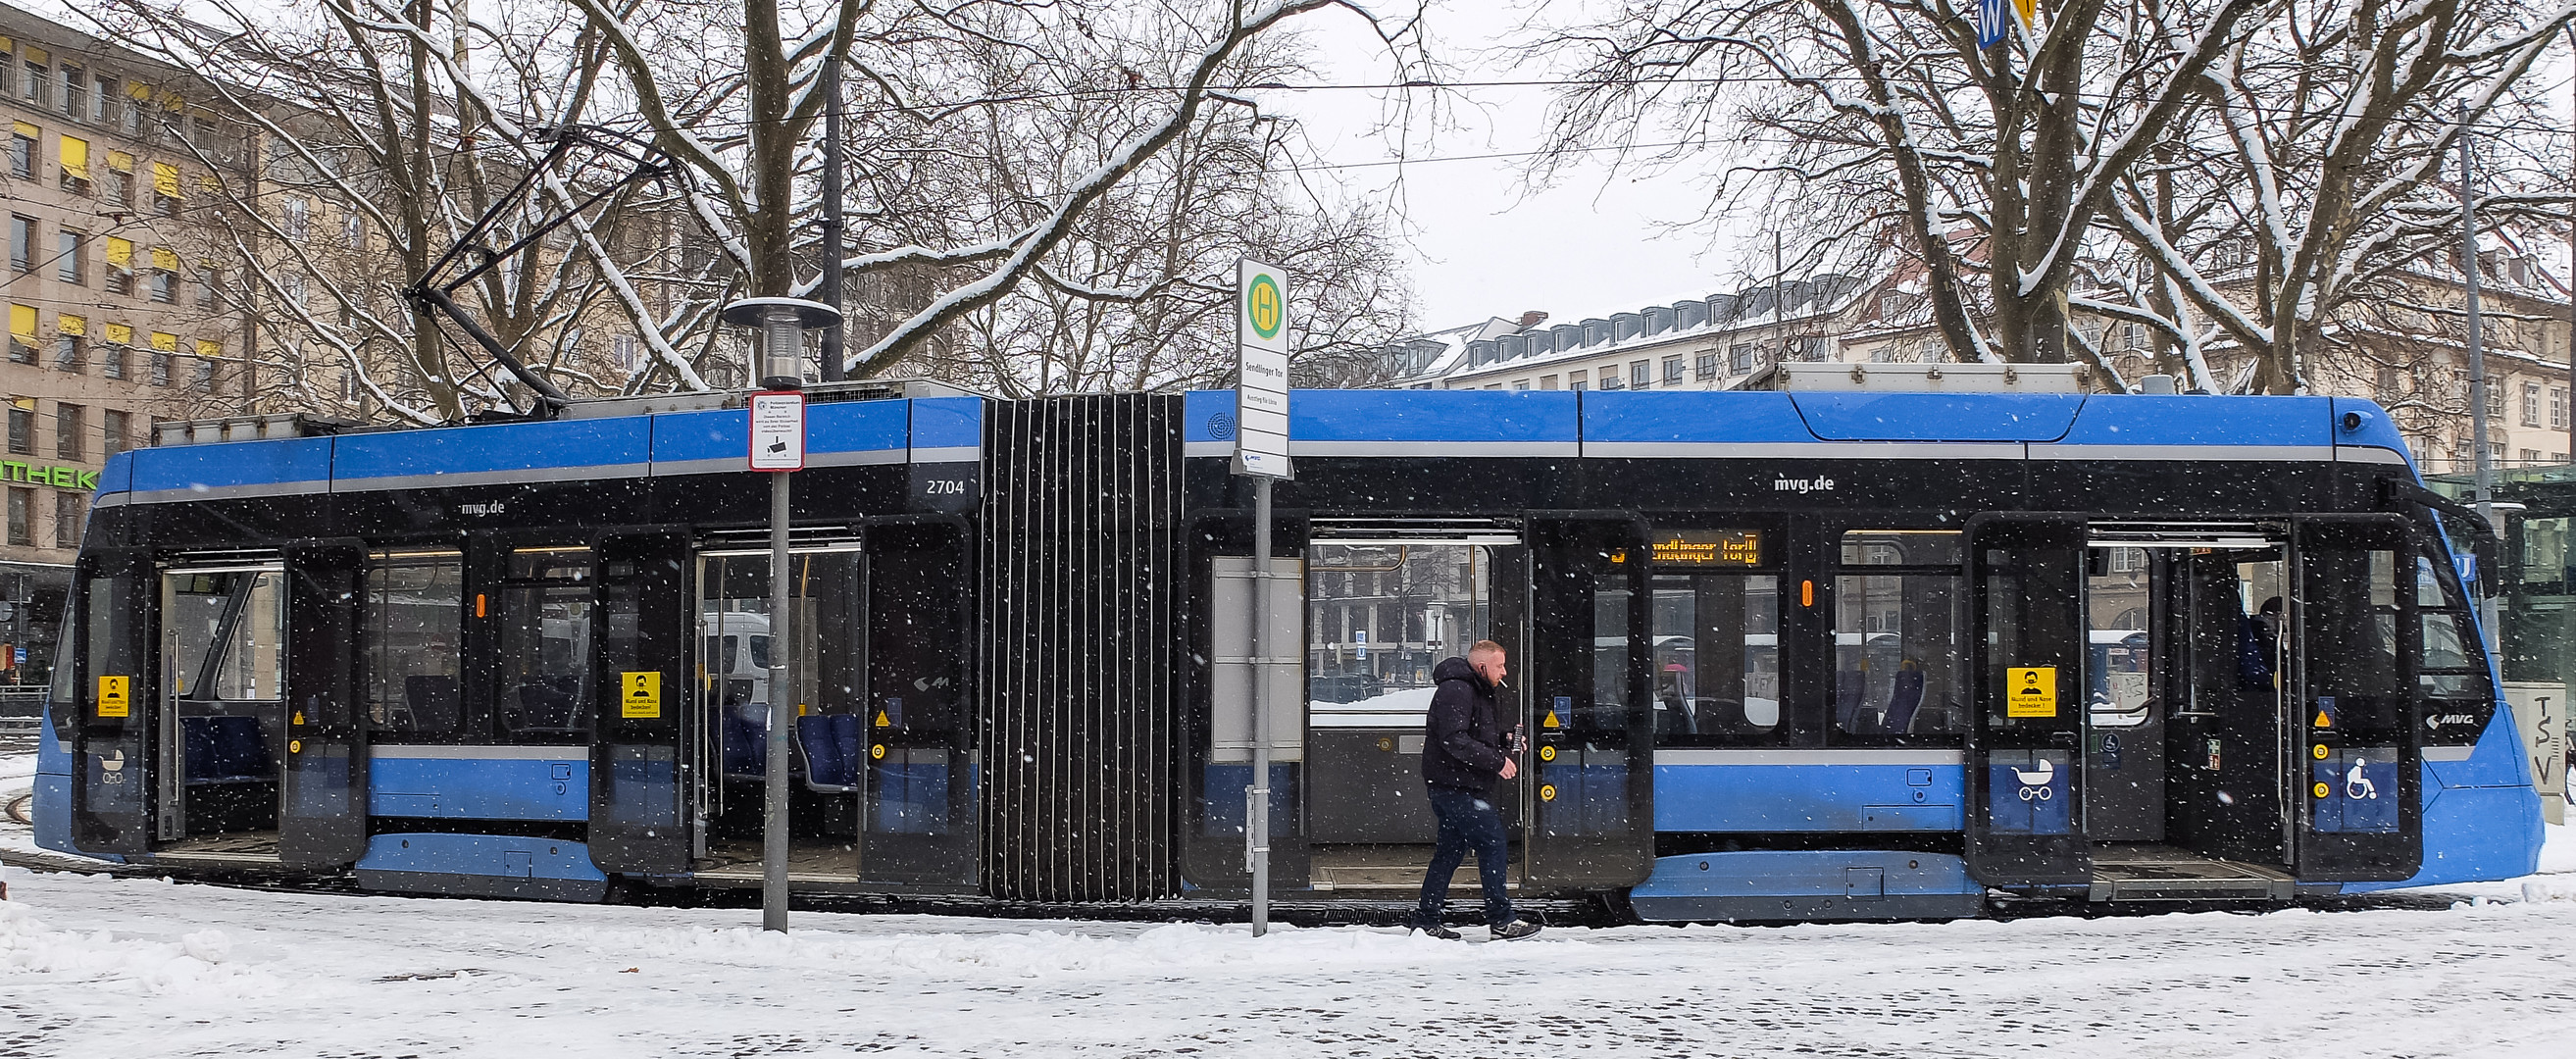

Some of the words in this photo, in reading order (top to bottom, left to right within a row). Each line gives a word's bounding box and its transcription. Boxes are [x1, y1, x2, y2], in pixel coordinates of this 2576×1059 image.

[1258, 287, 1273, 326] H
[1245, 361, 1275, 378] Sendlinger
[1275, 368, 1284, 378] Tor
[0, 460, 99, 490] THEK
[1774, 475, 1835, 494] mvg.de
[927, 479, 965, 495] 2704
[462, 499, 505, 518] mvg.de
[2440, 714, 2474, 724] MVG
